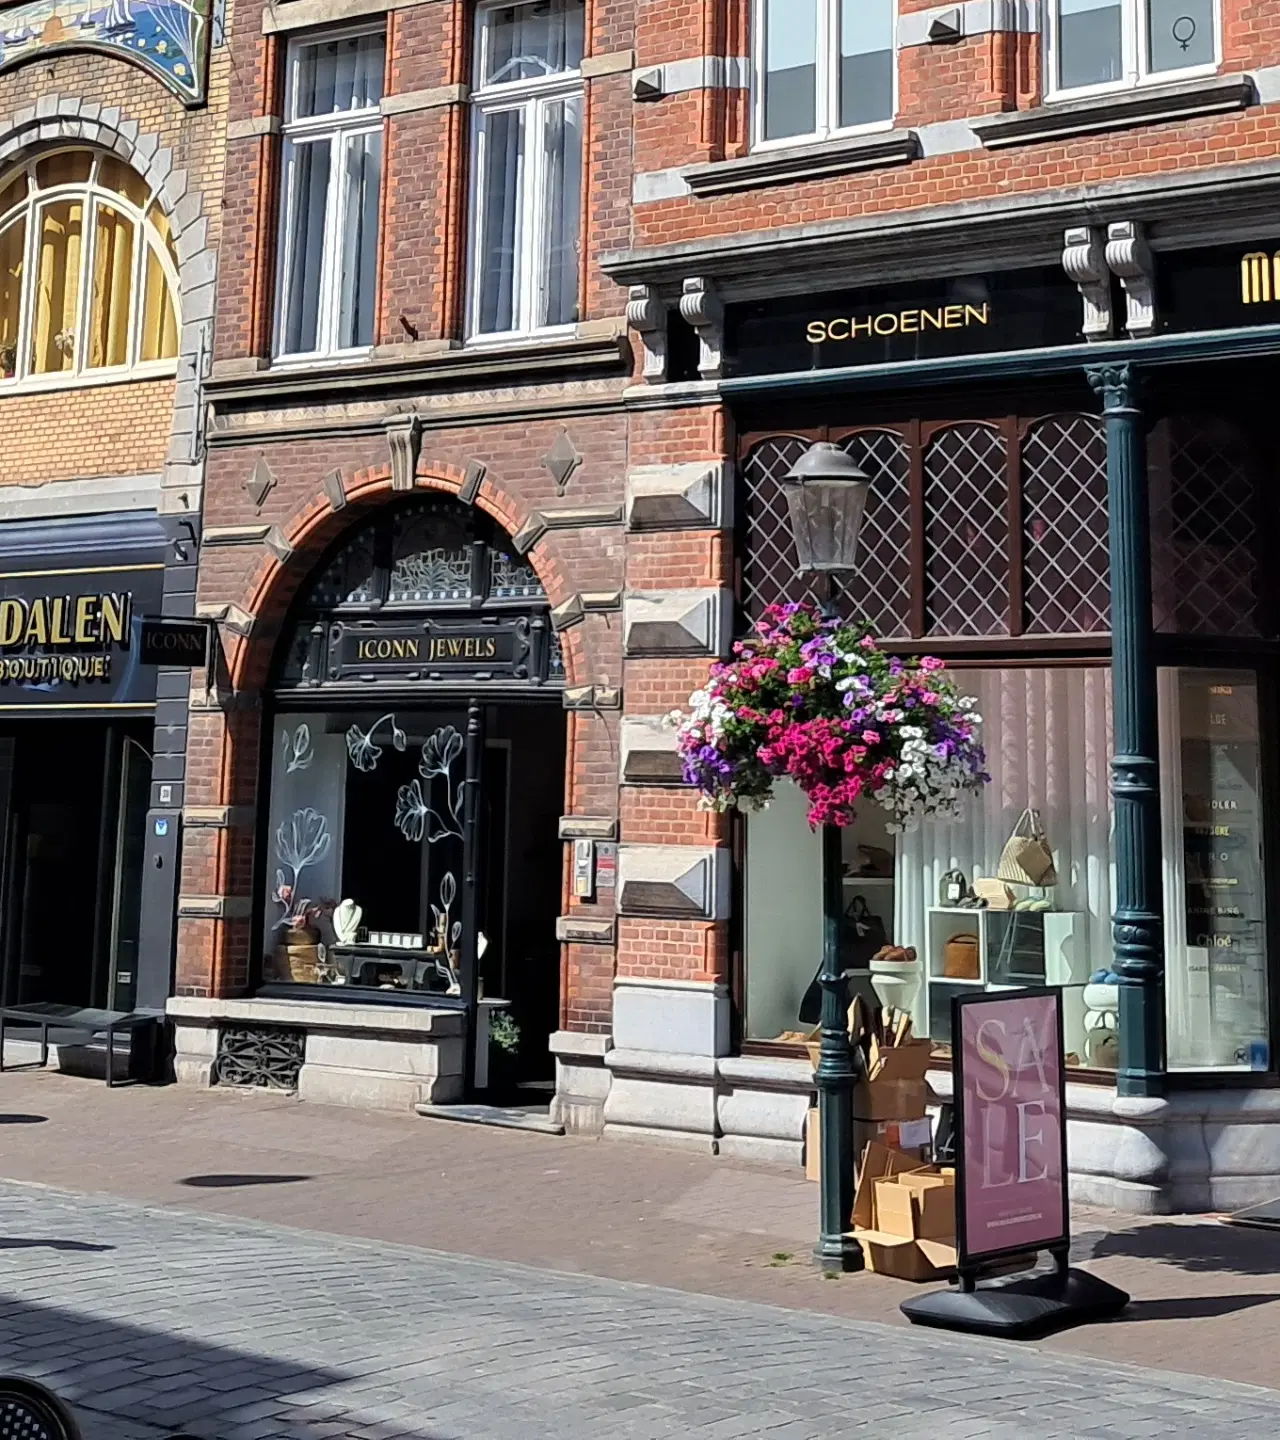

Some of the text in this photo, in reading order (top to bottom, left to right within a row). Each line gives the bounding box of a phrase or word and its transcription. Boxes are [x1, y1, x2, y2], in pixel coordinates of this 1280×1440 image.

[806, 301, 988, 344] SCHOENEN
[146, 631, 203, 651] ICONN
[358, 637, 496, 661] ICONN JEWELS
